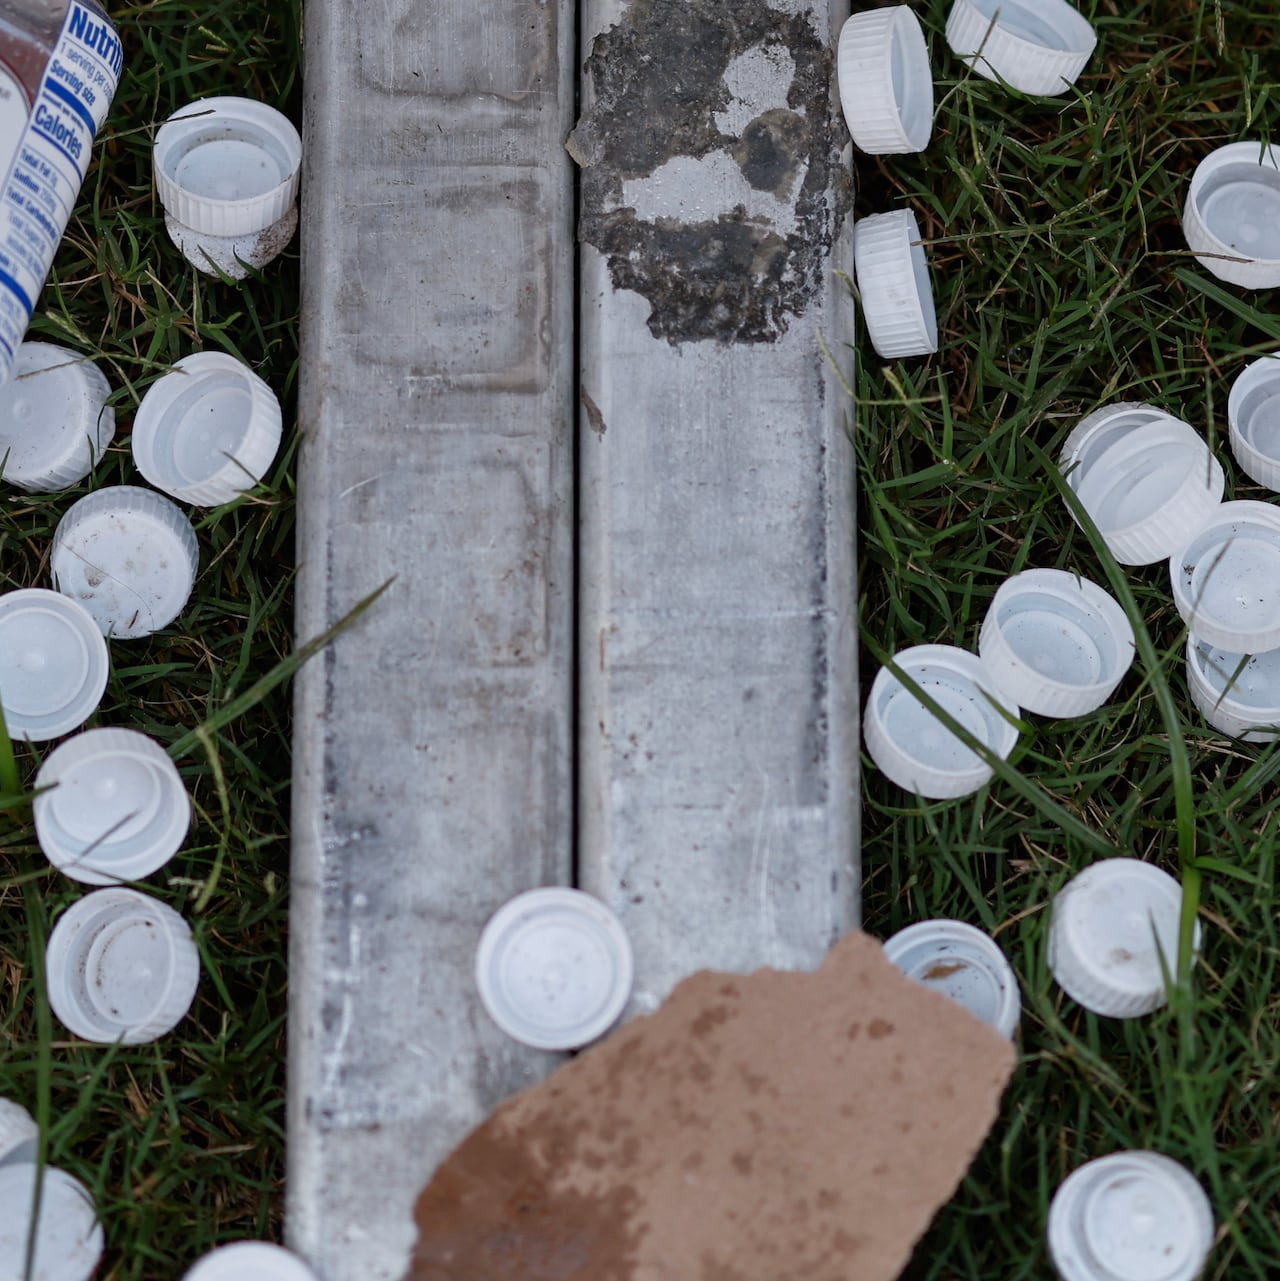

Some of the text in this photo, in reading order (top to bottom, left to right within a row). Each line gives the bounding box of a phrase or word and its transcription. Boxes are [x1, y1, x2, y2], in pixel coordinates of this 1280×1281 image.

[50, 59, 96, 106] Serving size
[67, 49, 96, 79] serving
[35, 104, 83, 160] Calories
